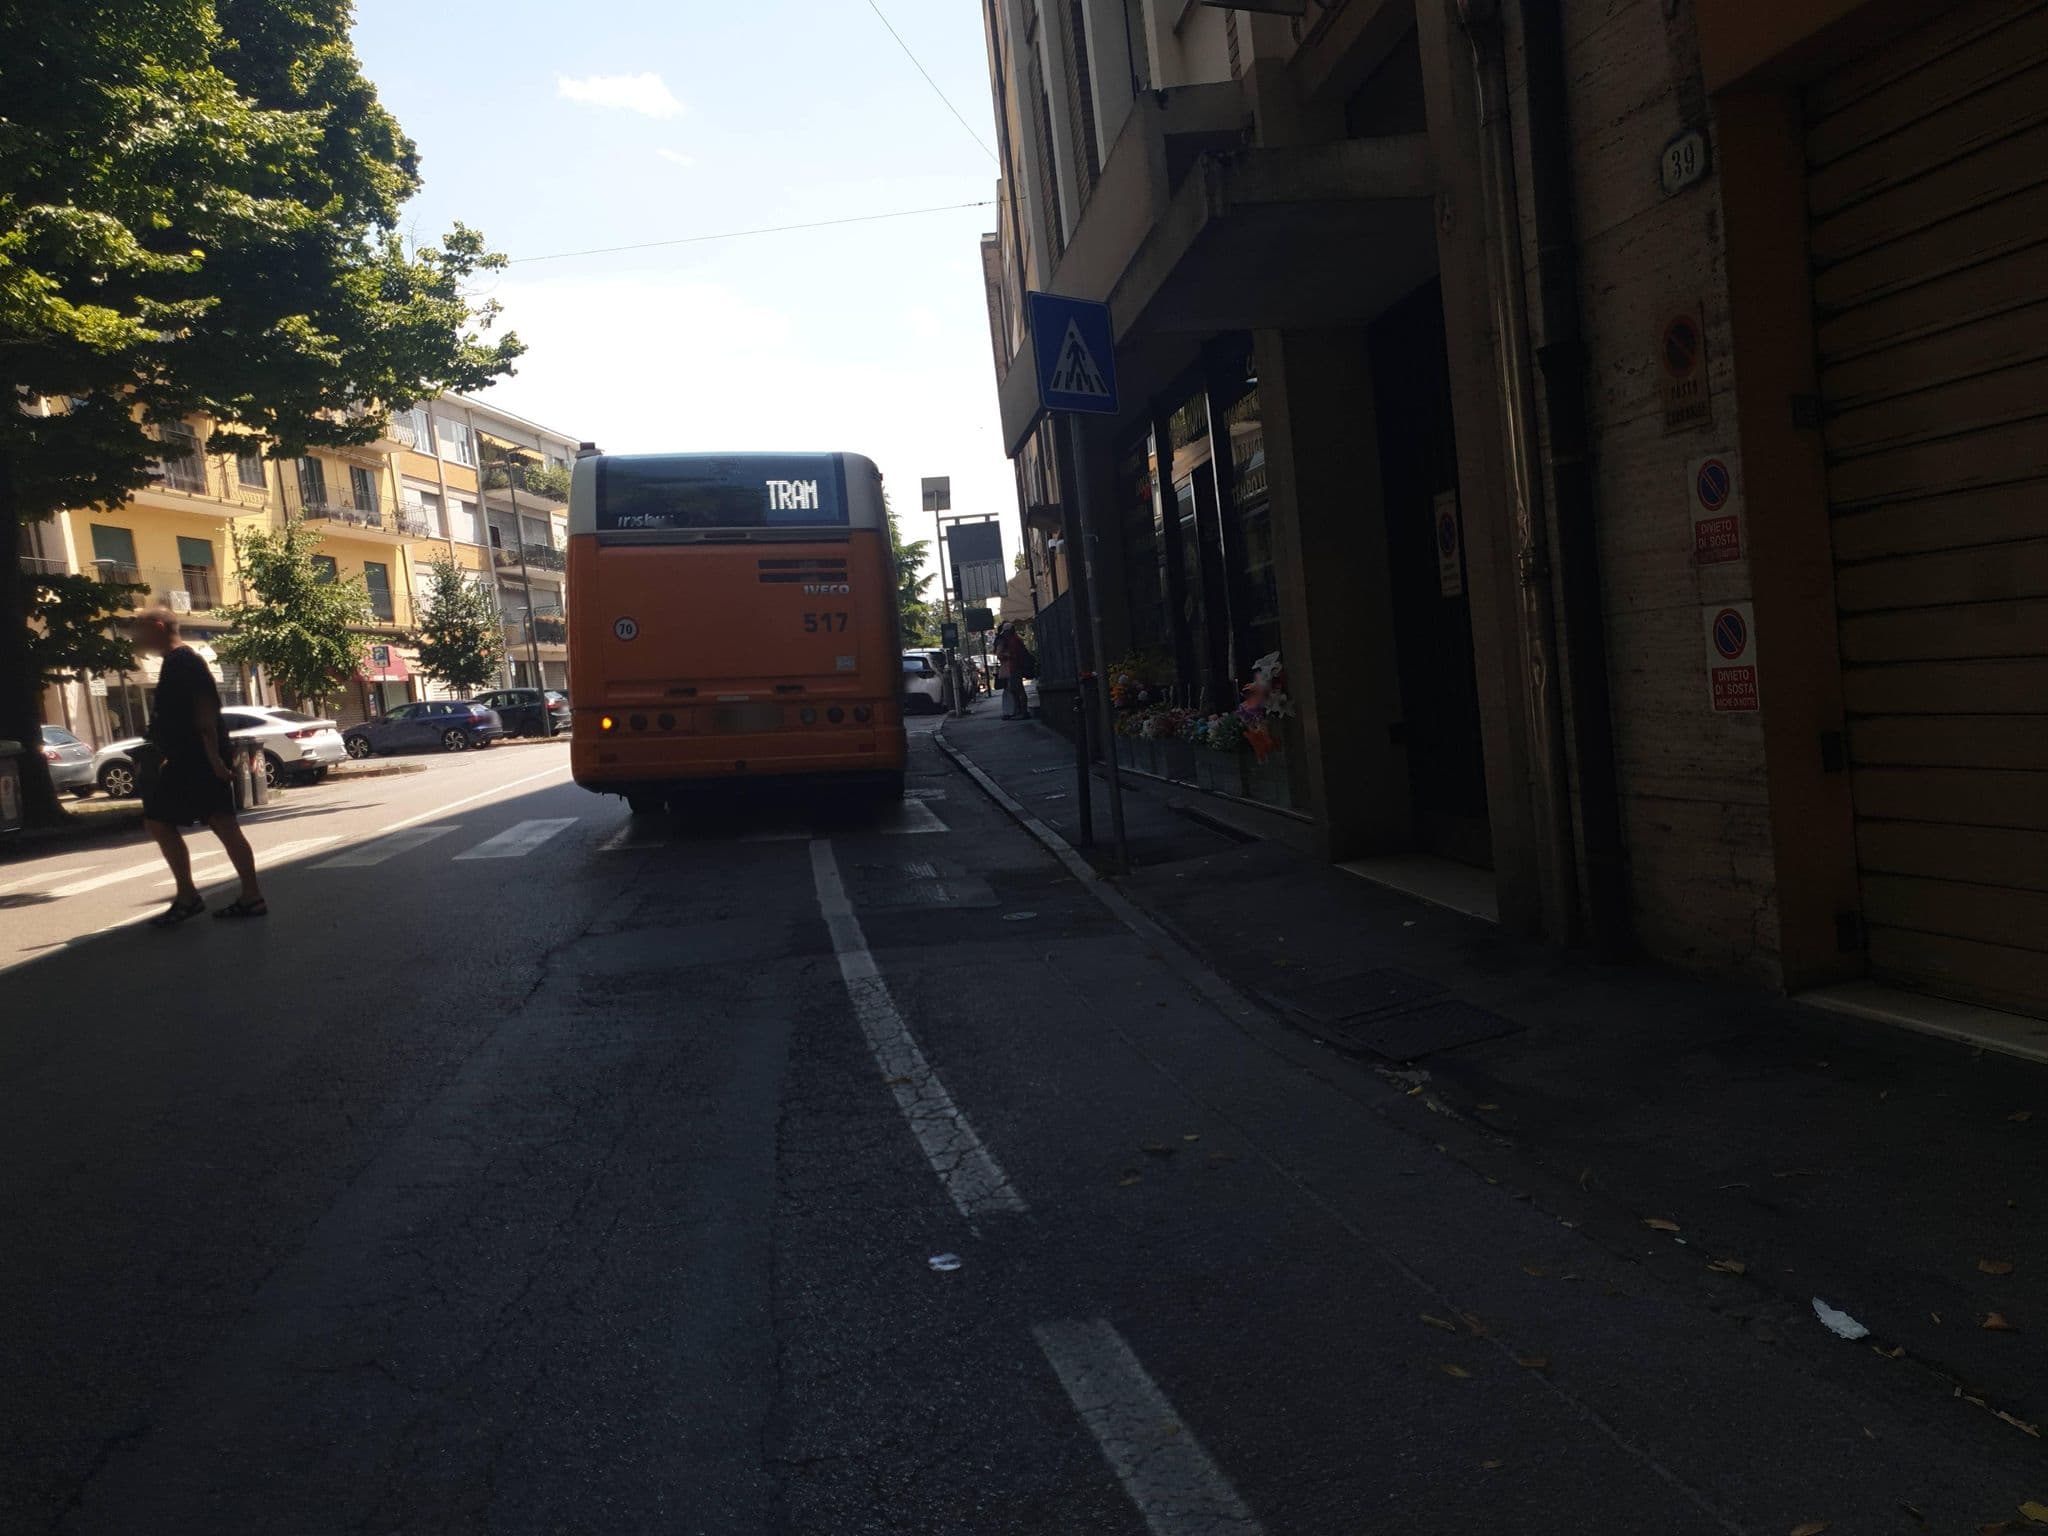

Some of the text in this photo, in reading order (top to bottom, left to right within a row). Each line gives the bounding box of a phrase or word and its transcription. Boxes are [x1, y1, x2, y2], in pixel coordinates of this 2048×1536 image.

[1671, 143, 1695, 180] 39
[766, 480, 819, 510] TRAM
[1701, 519, 1732, 535] DIVIETO
[619, 623, 633, 635] 70
[804, 612, 848, 632] 517
[1718, 669, 1750, 682] DIVIETO
[1715, 681, 1755, 696] DI SOSTA
